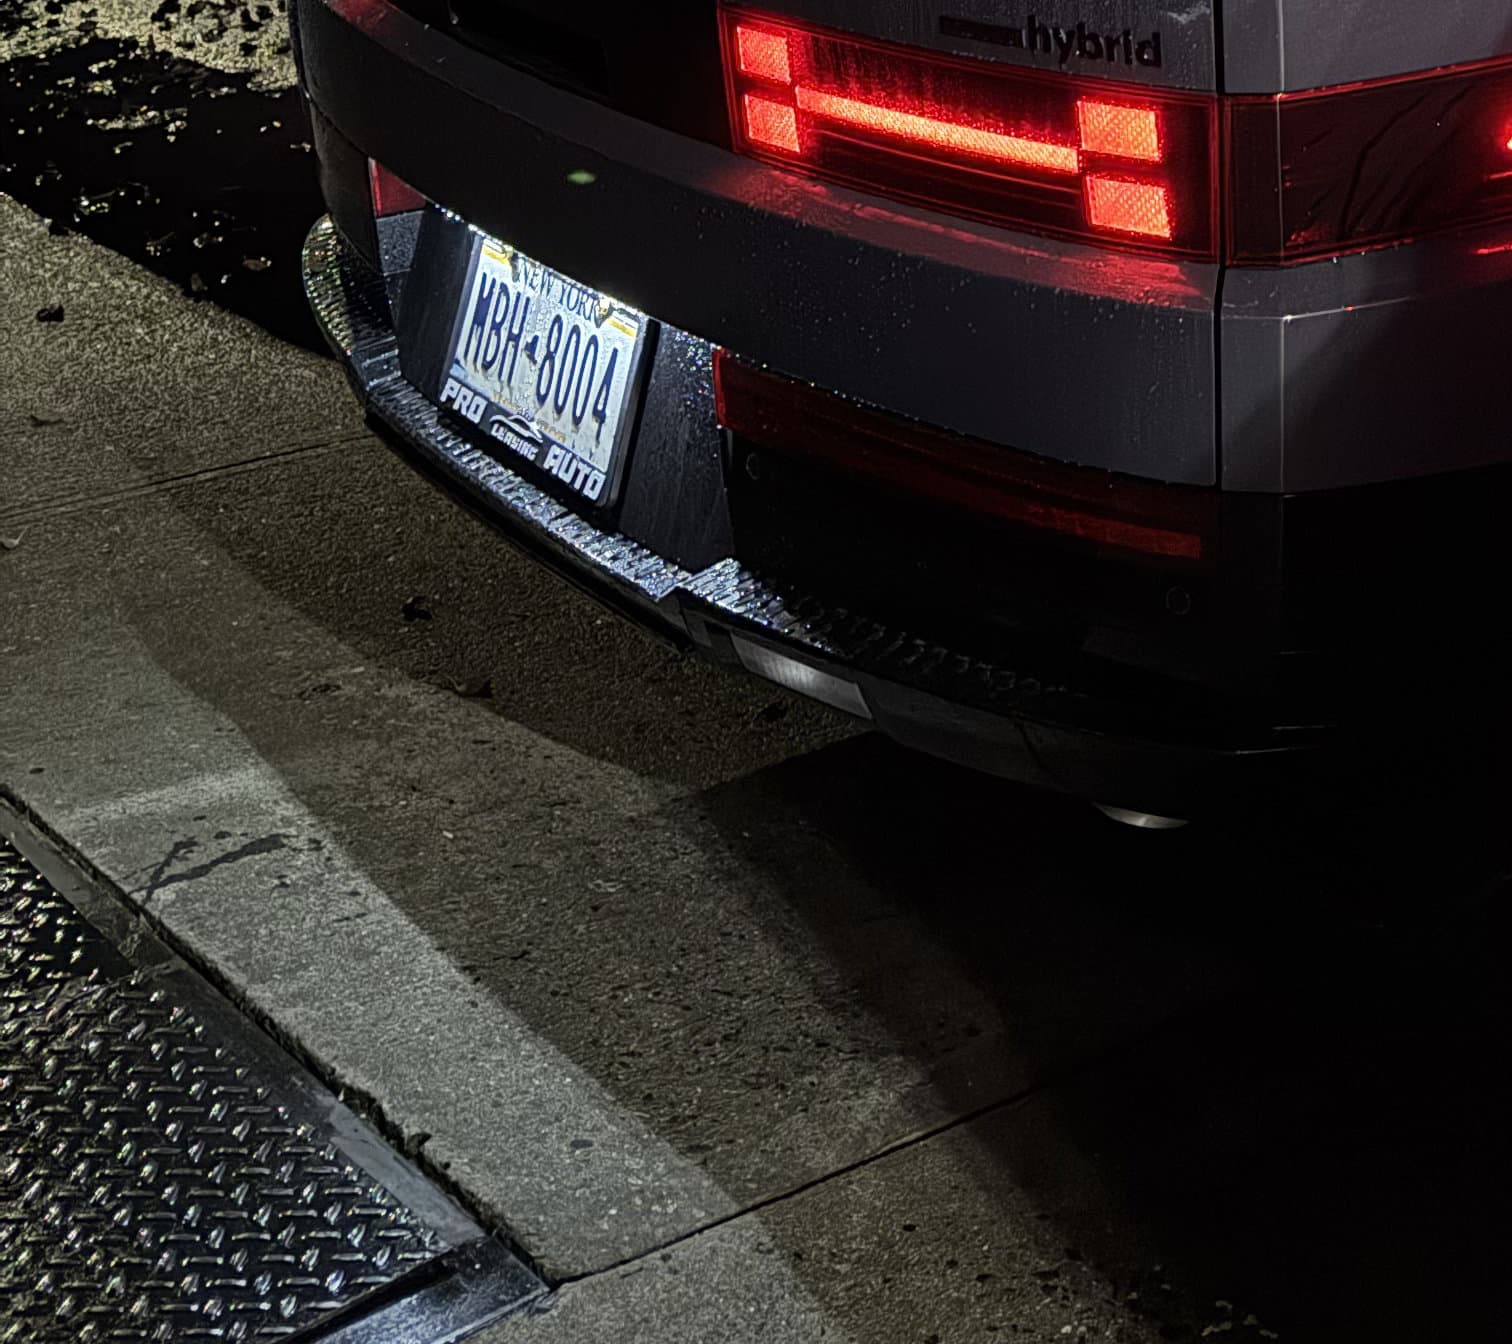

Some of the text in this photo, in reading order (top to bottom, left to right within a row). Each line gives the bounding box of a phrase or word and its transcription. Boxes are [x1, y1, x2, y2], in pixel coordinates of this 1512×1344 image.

[1026, 15, 1162, 70] hybrid
[515, 257, 556, 295] NEW
[440, 378, 488, 425] PRO
[543, 445, 607, 502] AUTO
